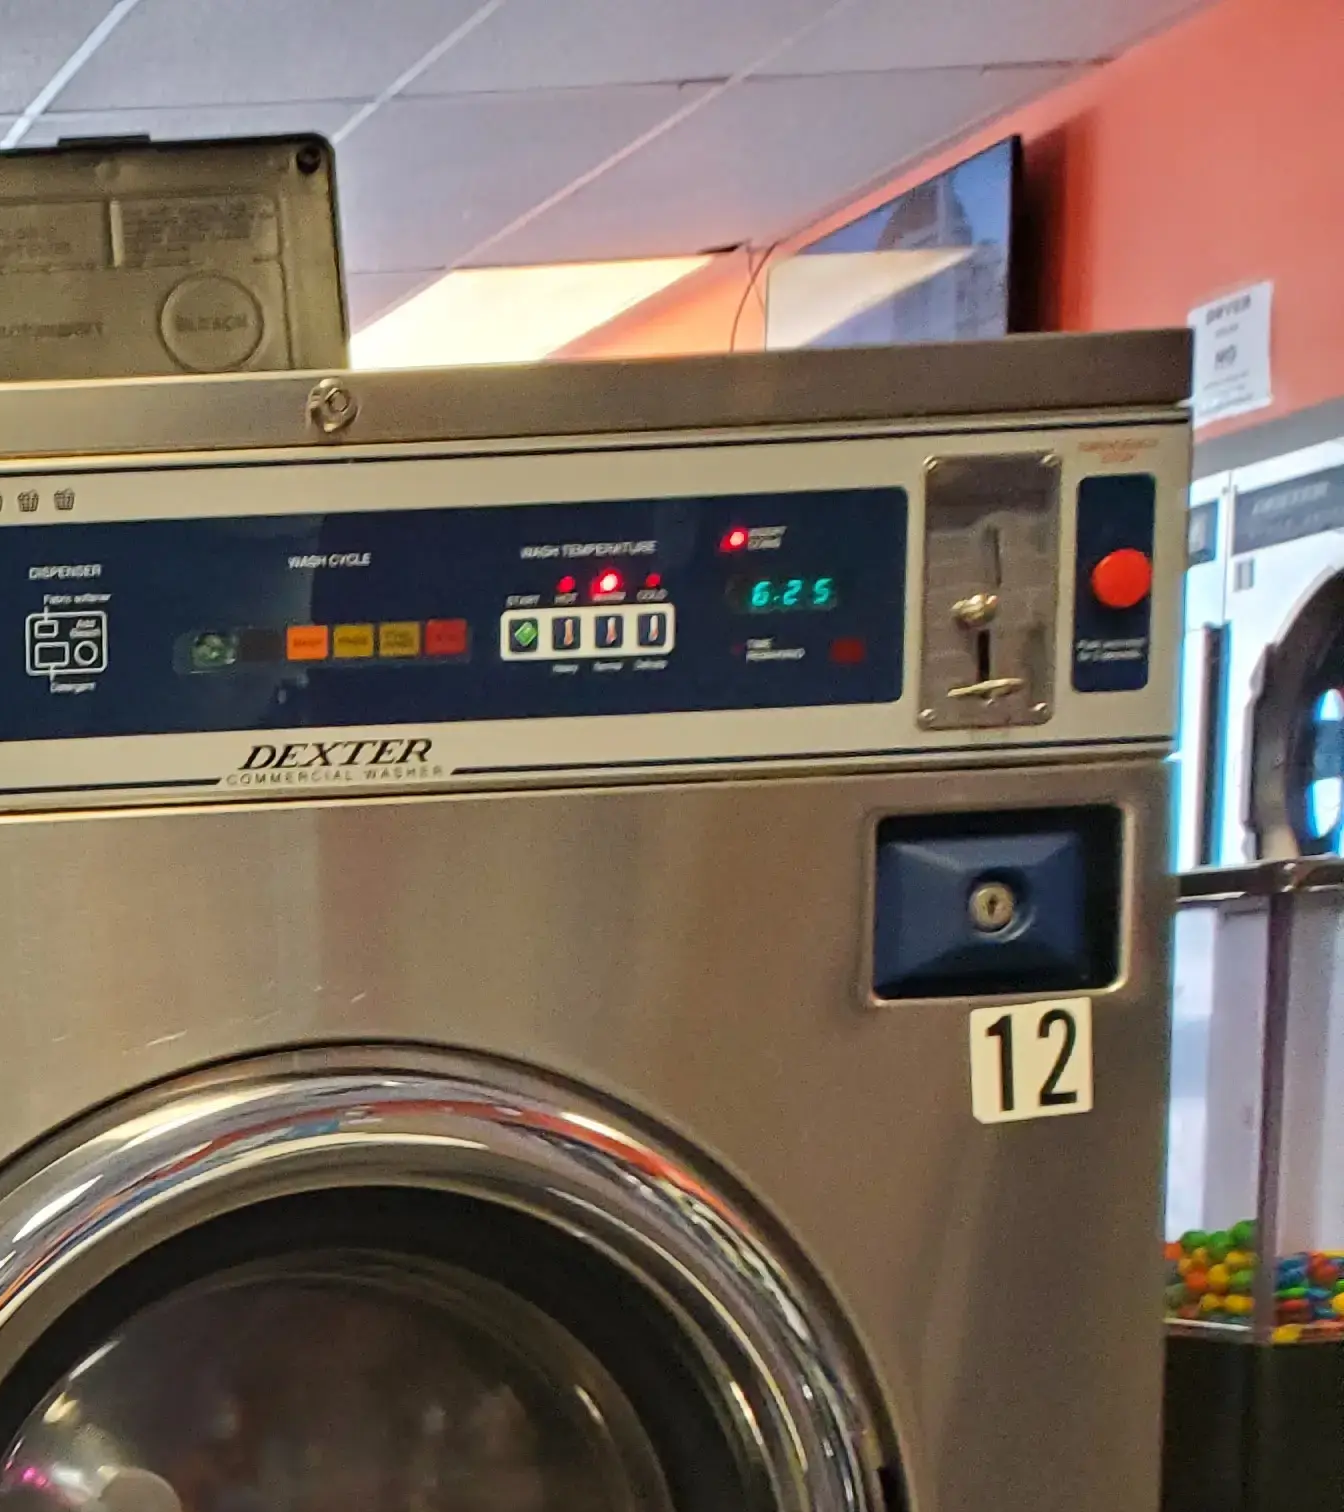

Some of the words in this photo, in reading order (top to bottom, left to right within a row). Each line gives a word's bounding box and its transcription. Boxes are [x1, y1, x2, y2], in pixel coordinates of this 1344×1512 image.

[288, 555, 327, 569] WASH
[329, 553, 371, 567] CYCLE
[752, 578, 833, 606] 6.25
[238, 738, 432, 770] DEXTER
[226, 769, 353, 785] COMMERCIAL
[364, 766, 443, 780] WASHER
[986, 1008, 1077, 1112] 12
